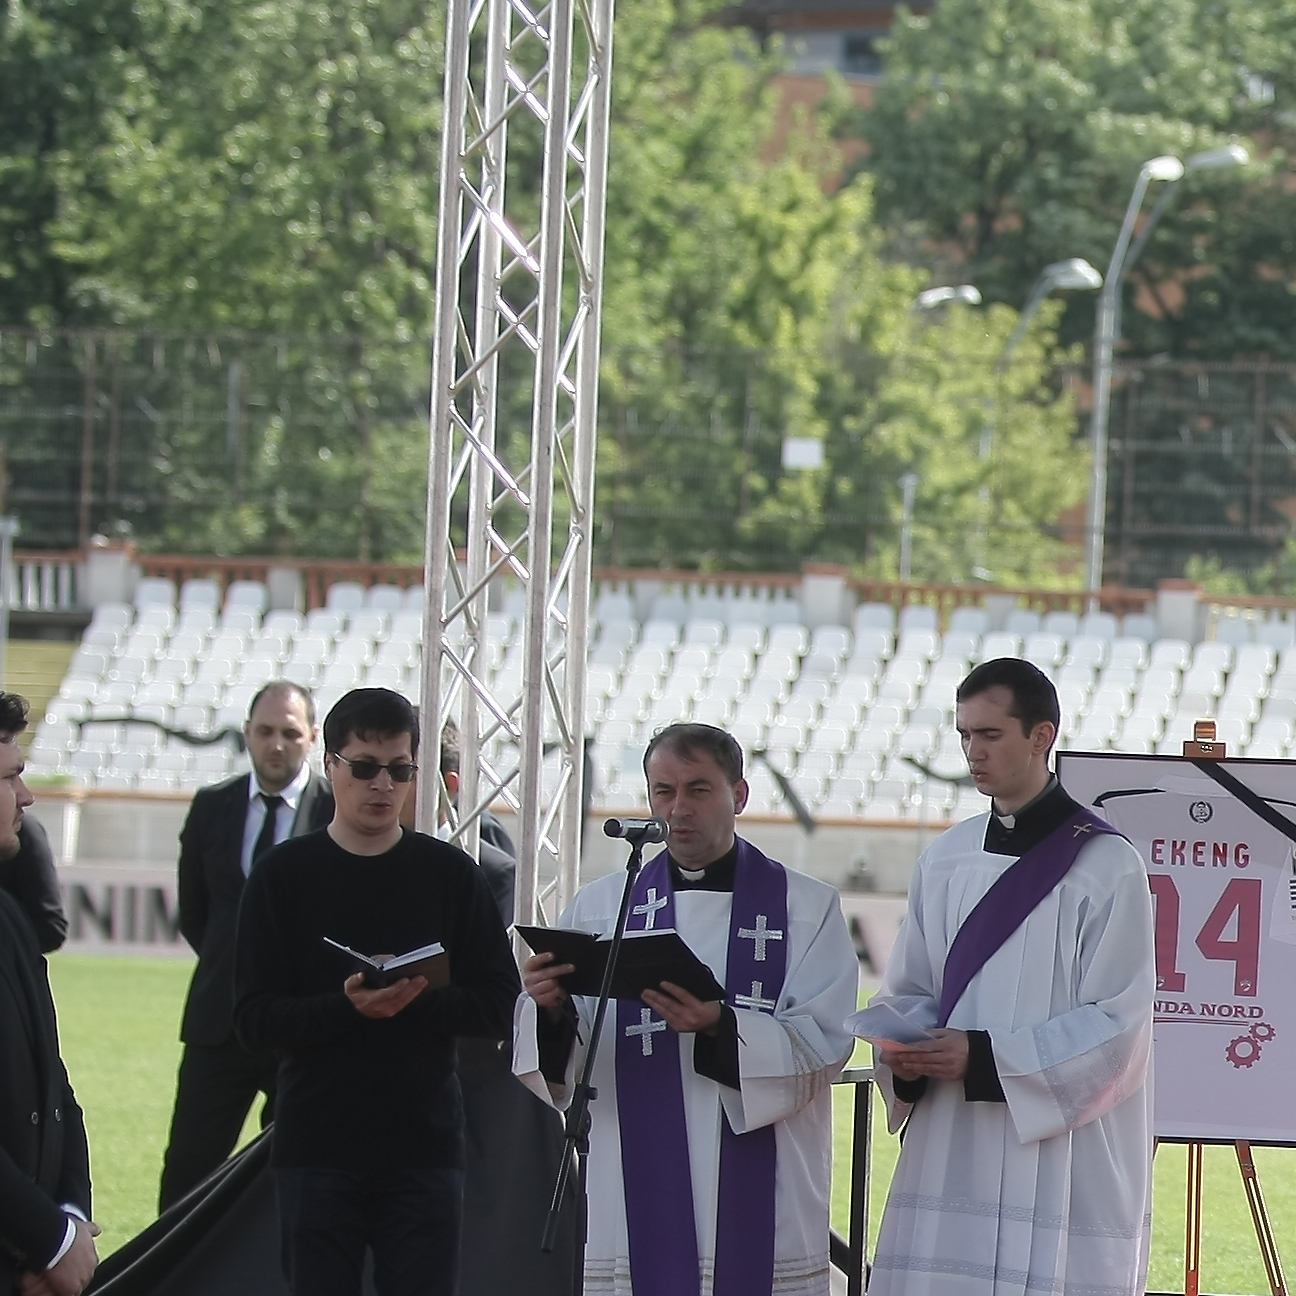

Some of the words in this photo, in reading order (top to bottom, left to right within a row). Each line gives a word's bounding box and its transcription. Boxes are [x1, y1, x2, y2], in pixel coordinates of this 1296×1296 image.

[1151, 838, 1251, 869] EKENG
[1147, 874, 1263, 998] 14
[1200, 1002, 1264, 1019] NORD
